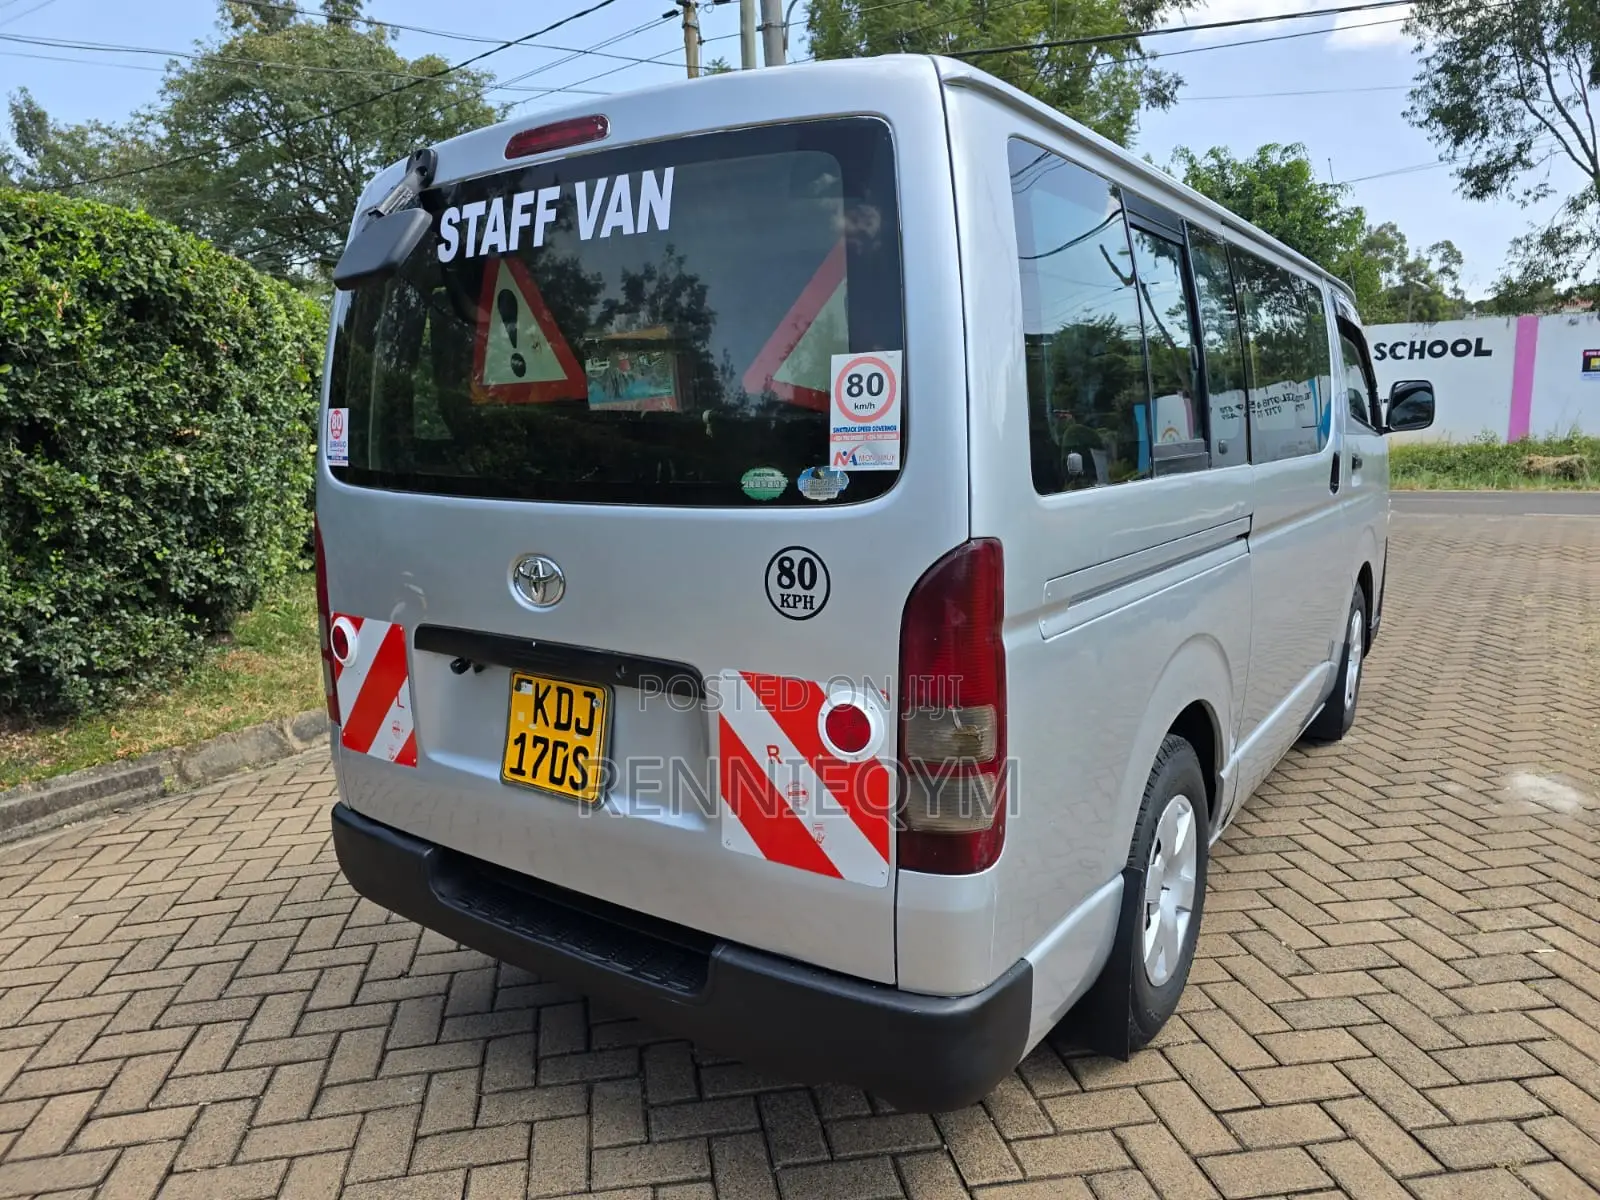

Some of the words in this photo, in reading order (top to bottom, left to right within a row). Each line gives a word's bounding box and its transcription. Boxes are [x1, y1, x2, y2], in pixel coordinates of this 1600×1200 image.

[437, 186, 560, 263] STAFF
[574, 167, 675, 240] VAN
[1373, 337, 1493, 361] SCHOOL
[846, 372, 884, 398] 80
[854, 402, 875, 411] km/h
[857, 425, 872, 433] SPEED
[777, 556, 817, 590] 80
[780, 593, 815, 610] KPH
[533, 682, 597, 736] KDJ
[509, 732, 589, 791] 170S
[766, 745, 783, 764] R
